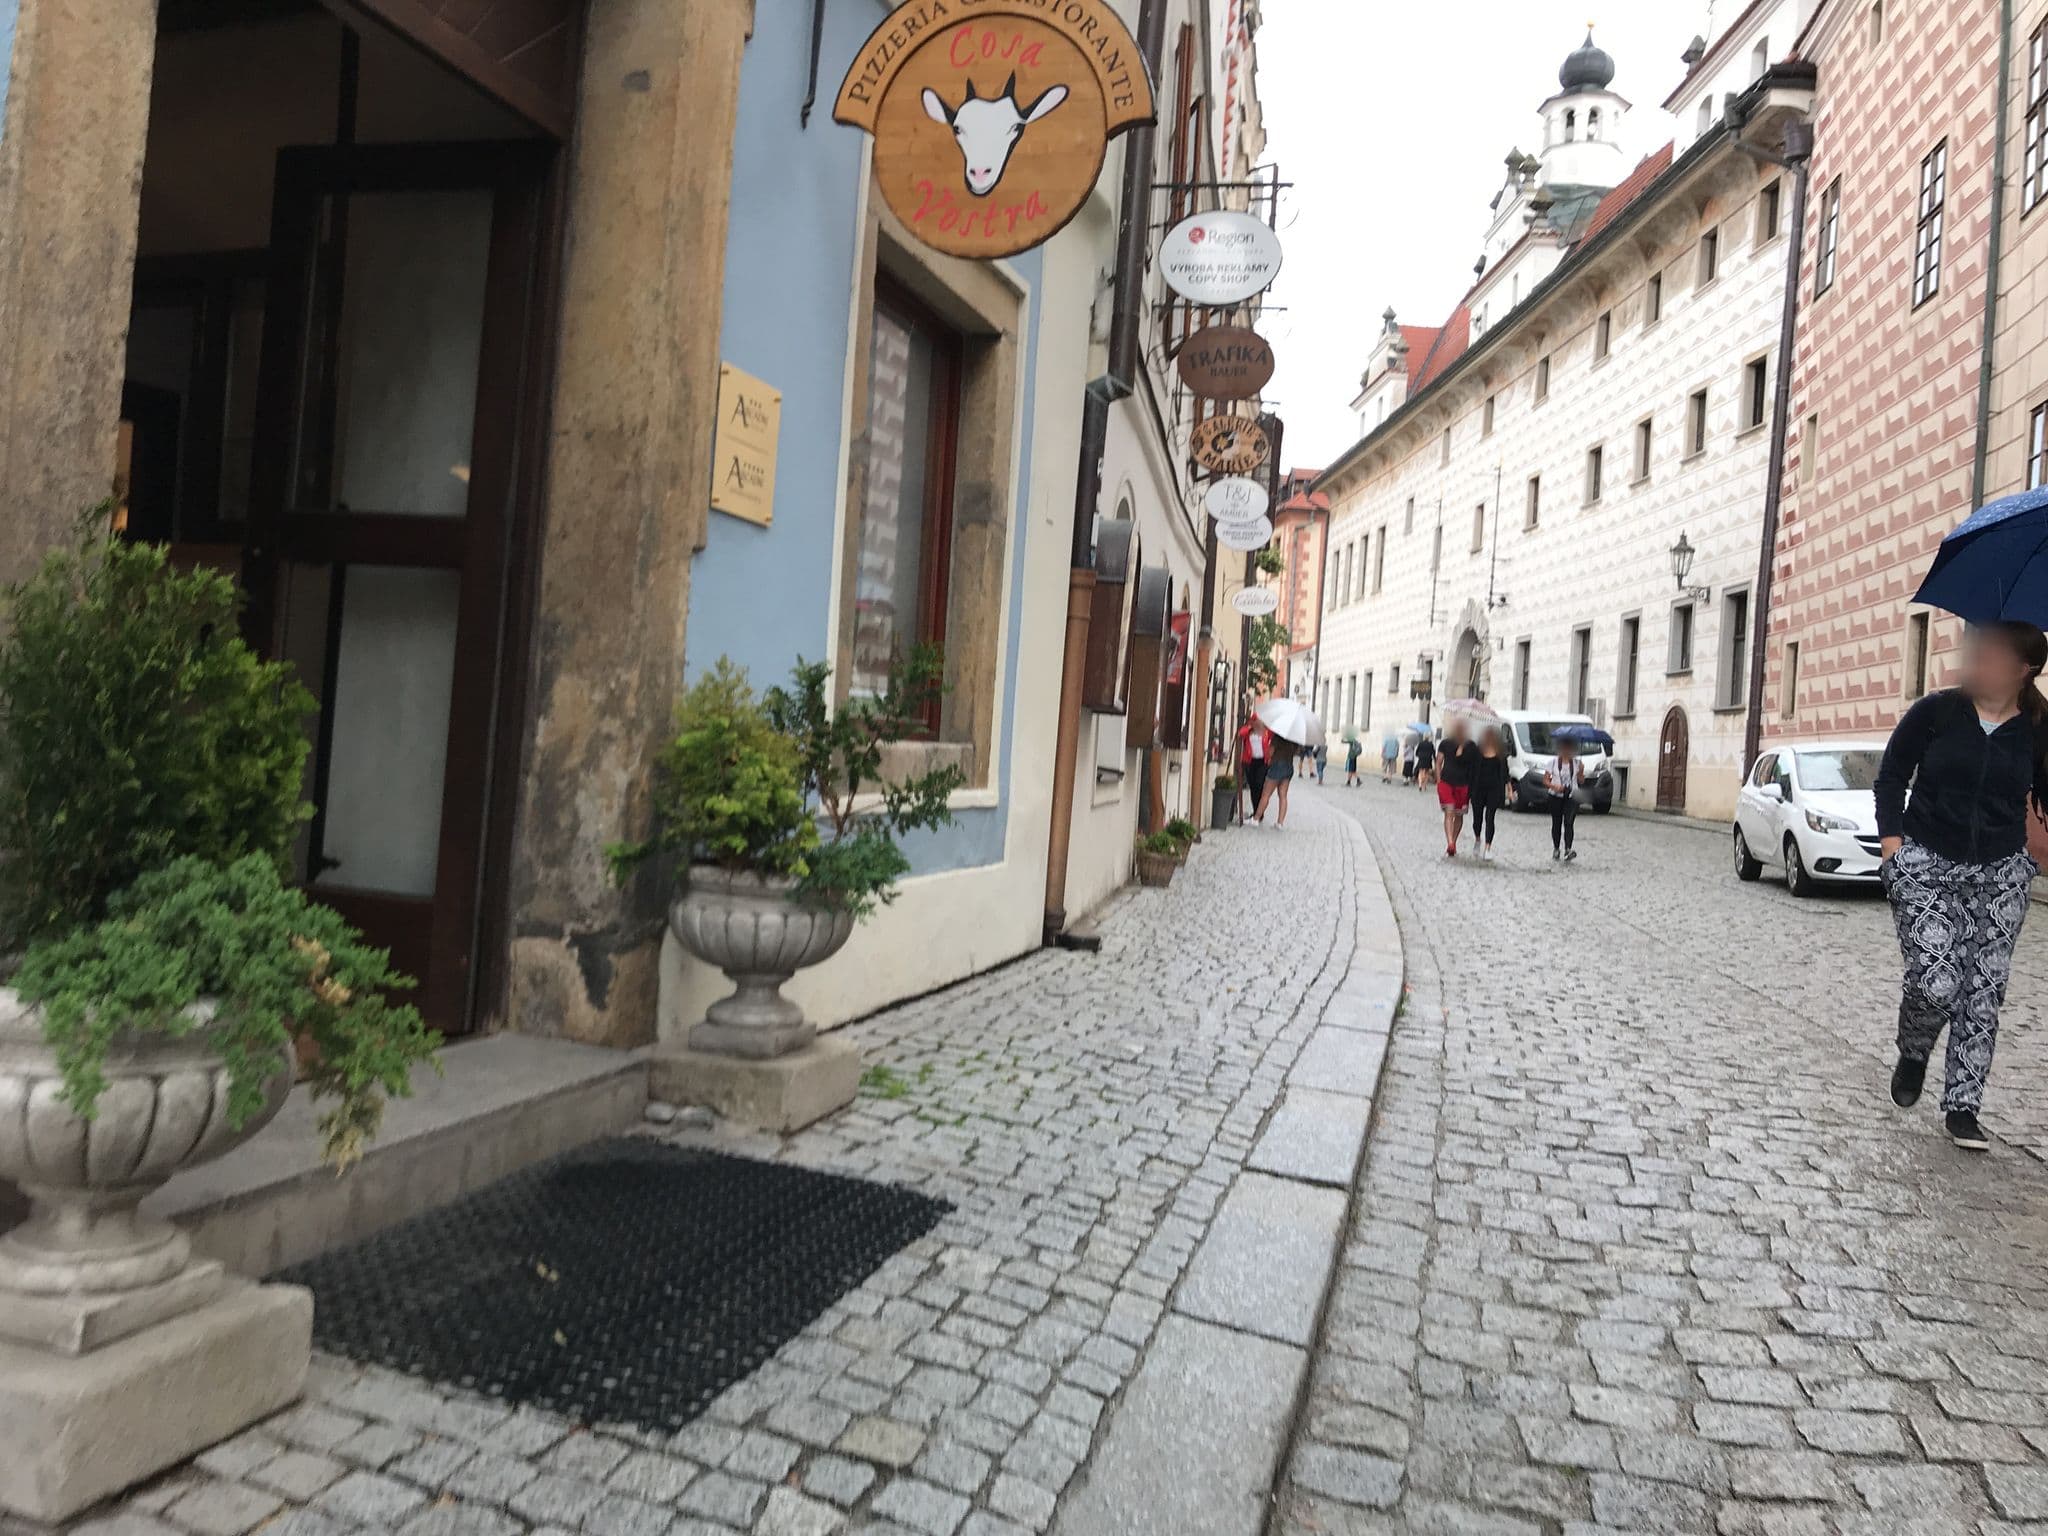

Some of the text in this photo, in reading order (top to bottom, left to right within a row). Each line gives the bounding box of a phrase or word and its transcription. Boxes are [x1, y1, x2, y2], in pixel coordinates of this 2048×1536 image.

[848, 0, 1134, 111] PIZZERIA TORANTE
[949, 25, 1045, 69] Cosa
[911, 179, 1049, 238] Vostra
[1208, 229, 1255, 248] Region
[1187, 274, 1251, 285] COPY SHOP
[1187, 344, 1268, 369] TRAFIKA
[1203, 452, 1255, 473] MARIE
